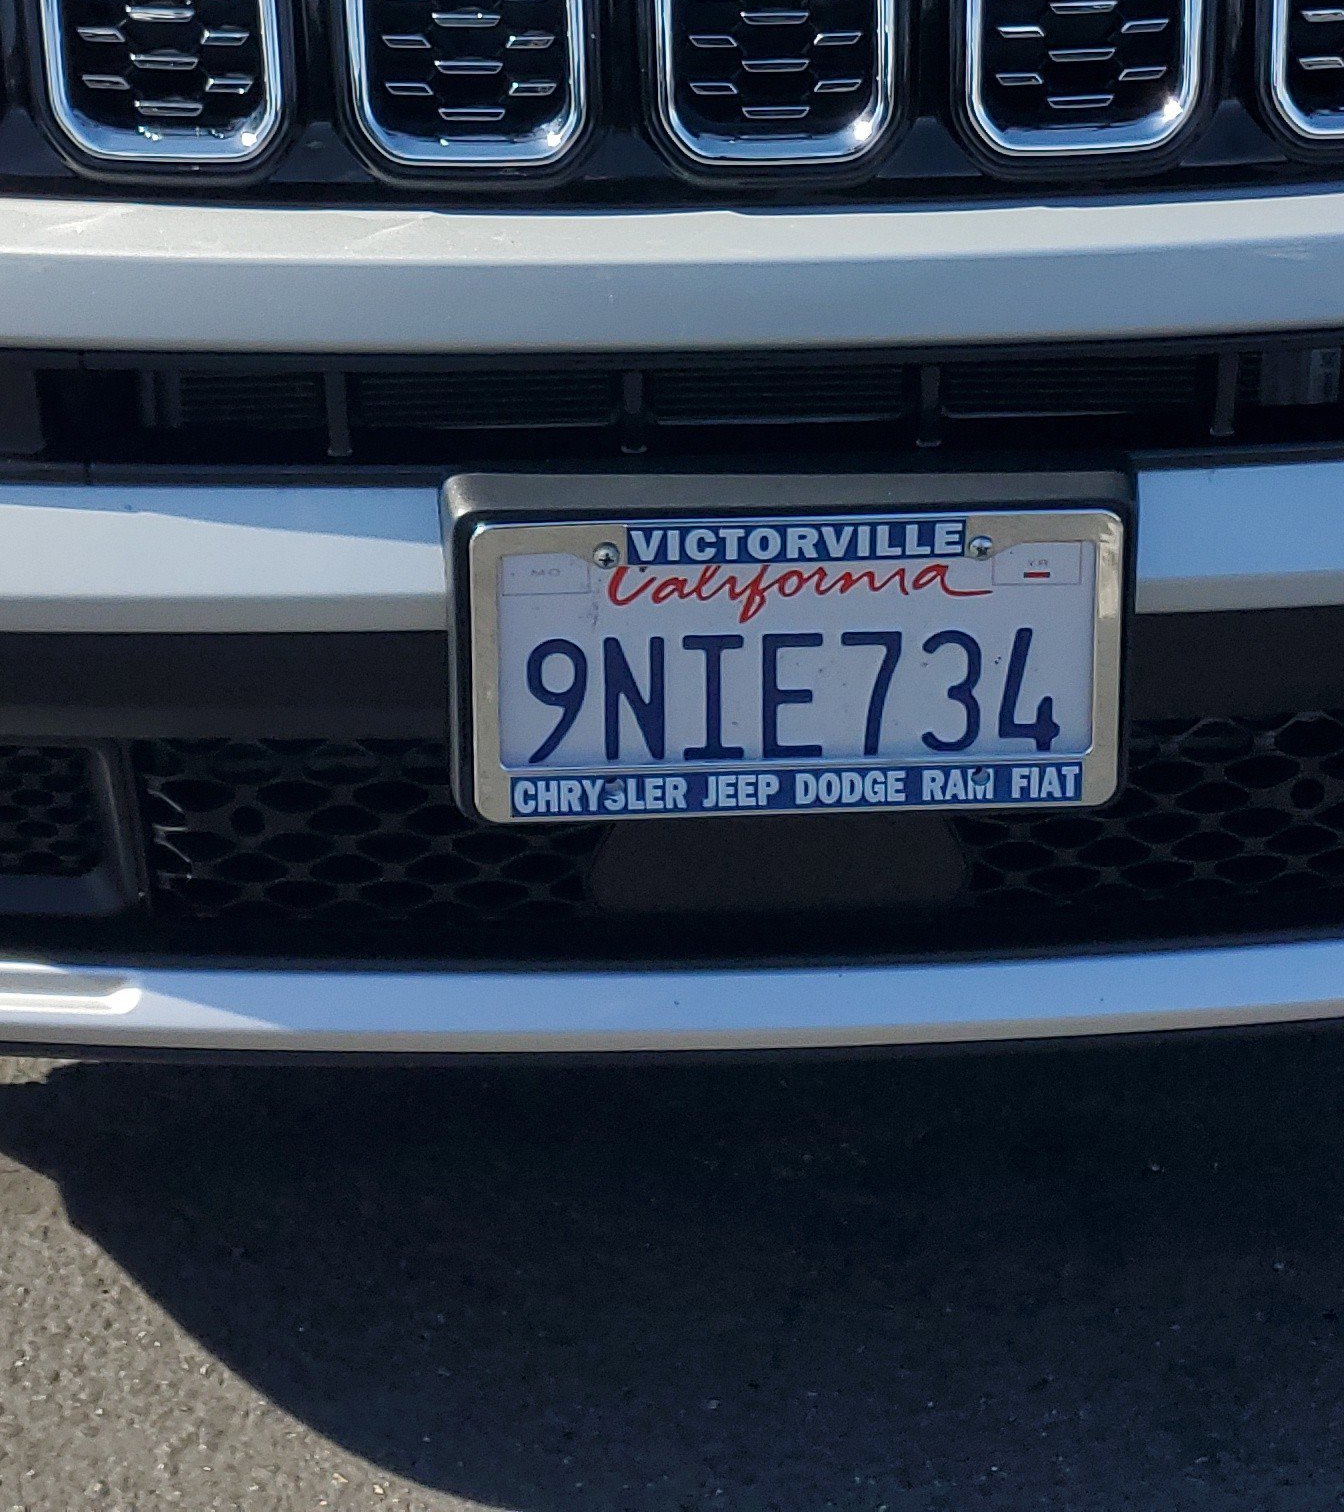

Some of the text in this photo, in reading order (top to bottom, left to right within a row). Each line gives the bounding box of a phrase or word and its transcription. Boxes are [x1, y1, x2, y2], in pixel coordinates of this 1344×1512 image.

[631, 522, 963, 563] VICTORVILLE
[526, 626, 1060, 765] 9NIE734
[702, 774, 781, 808] JEEP
[794, 769, 907, 805] DODGE
[921, 768, 995, 801] RAM
[1010, 766, 1080, 799] FIAT
